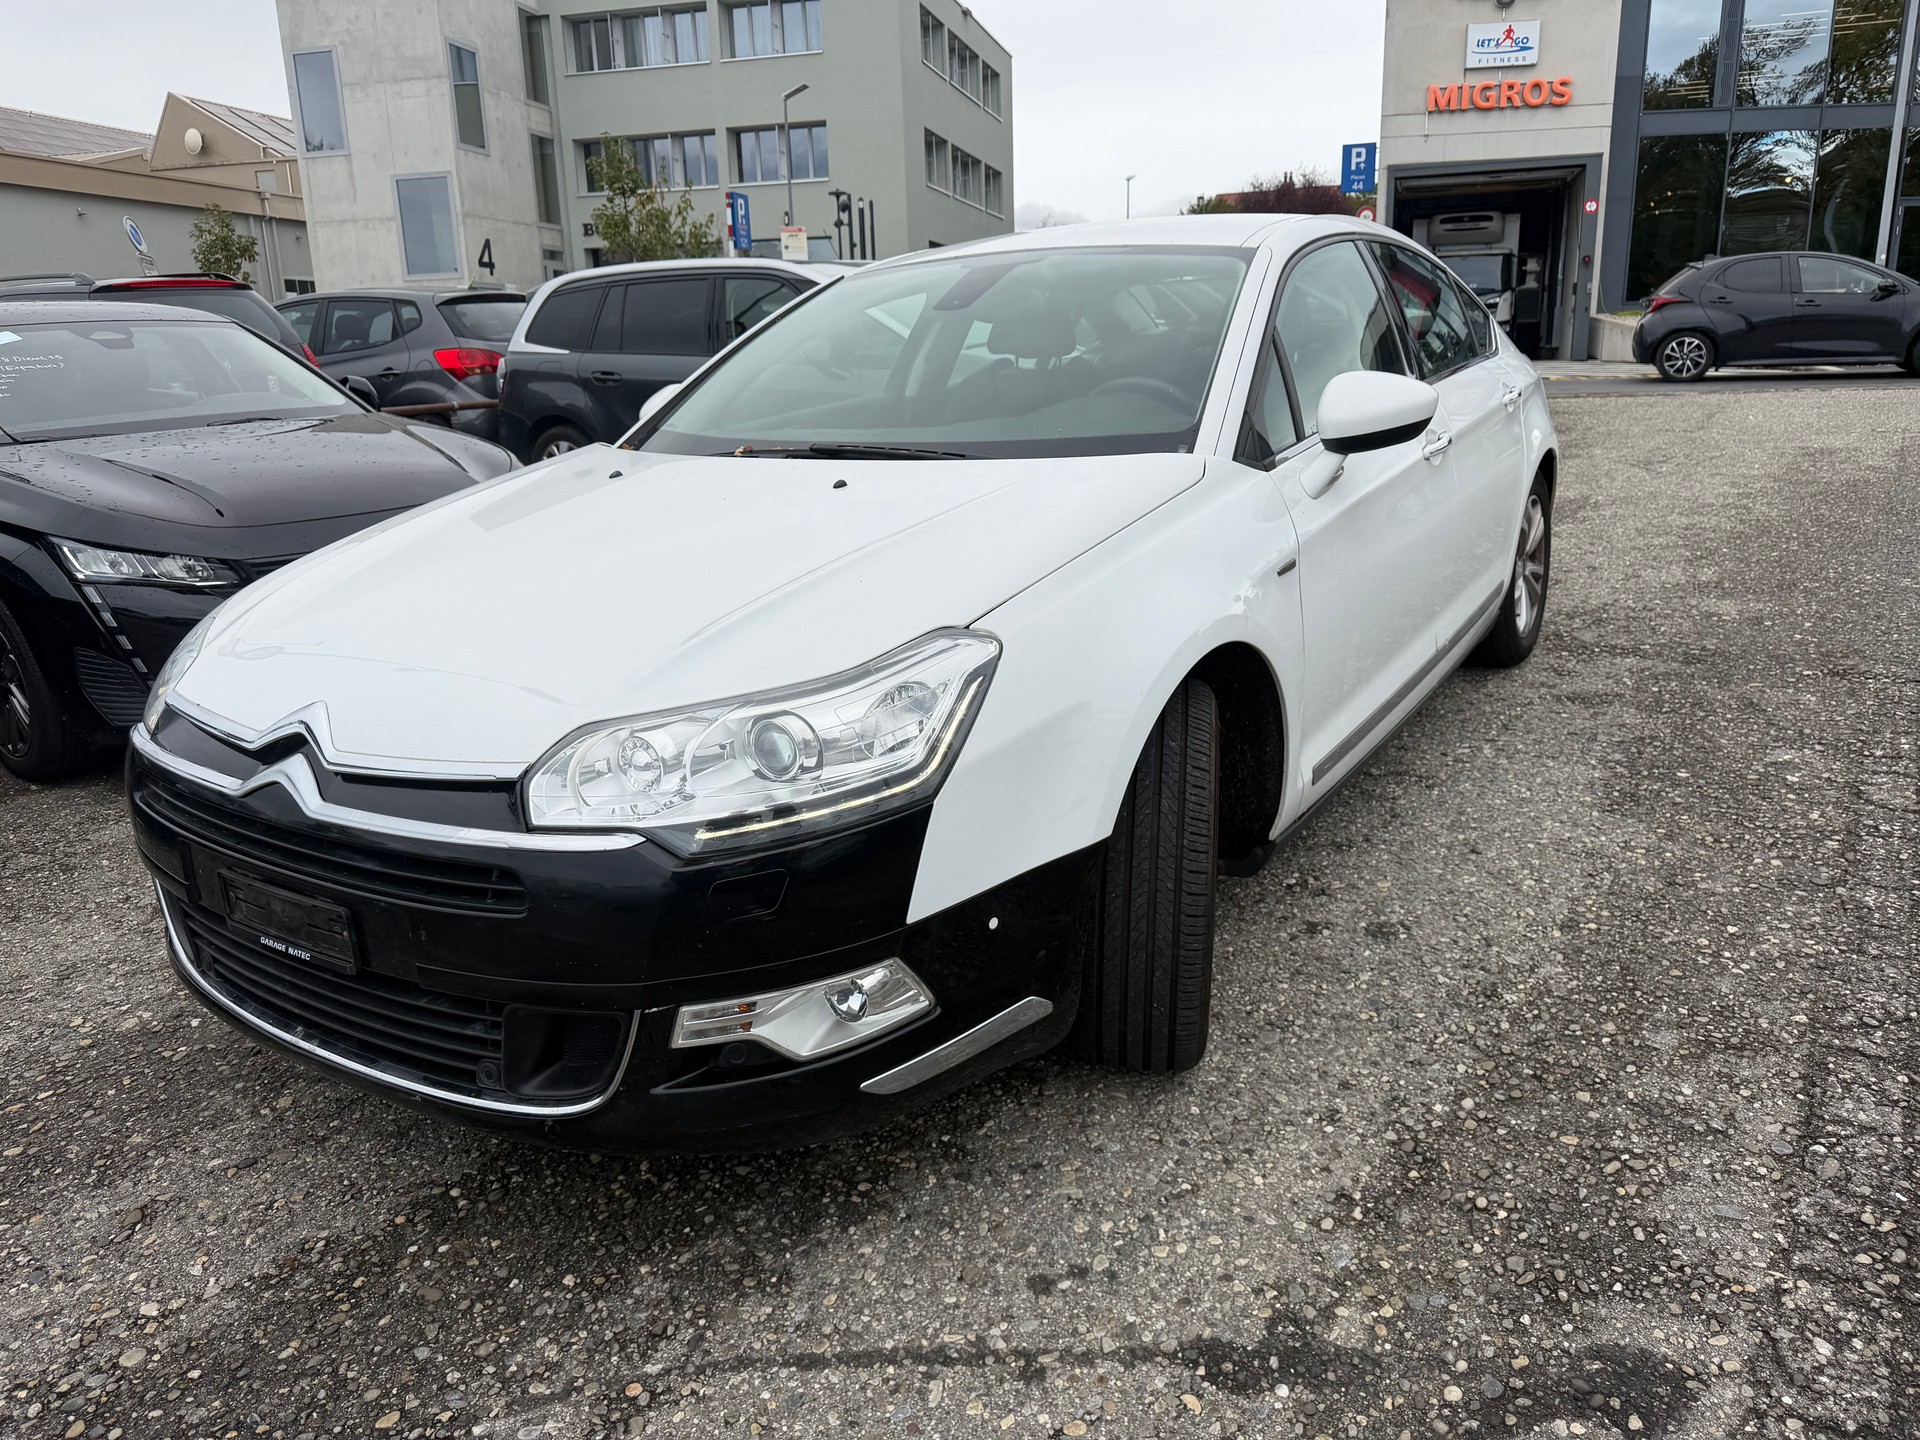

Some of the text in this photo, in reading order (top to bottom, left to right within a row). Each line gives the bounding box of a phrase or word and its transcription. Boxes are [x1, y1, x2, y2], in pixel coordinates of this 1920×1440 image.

[1476, 36, 1530, 48] LET'S GO
[1478, 56, 1527, 64] FITNESS
[1427, 75, 1573, 112] MIGROS
[1350, 147, 1366, 171] P
[1352, 181, 1364, 191] 44
[478, 238, 495, 276] 4
[260, 936, 311, 961] GARAGE NATEC
